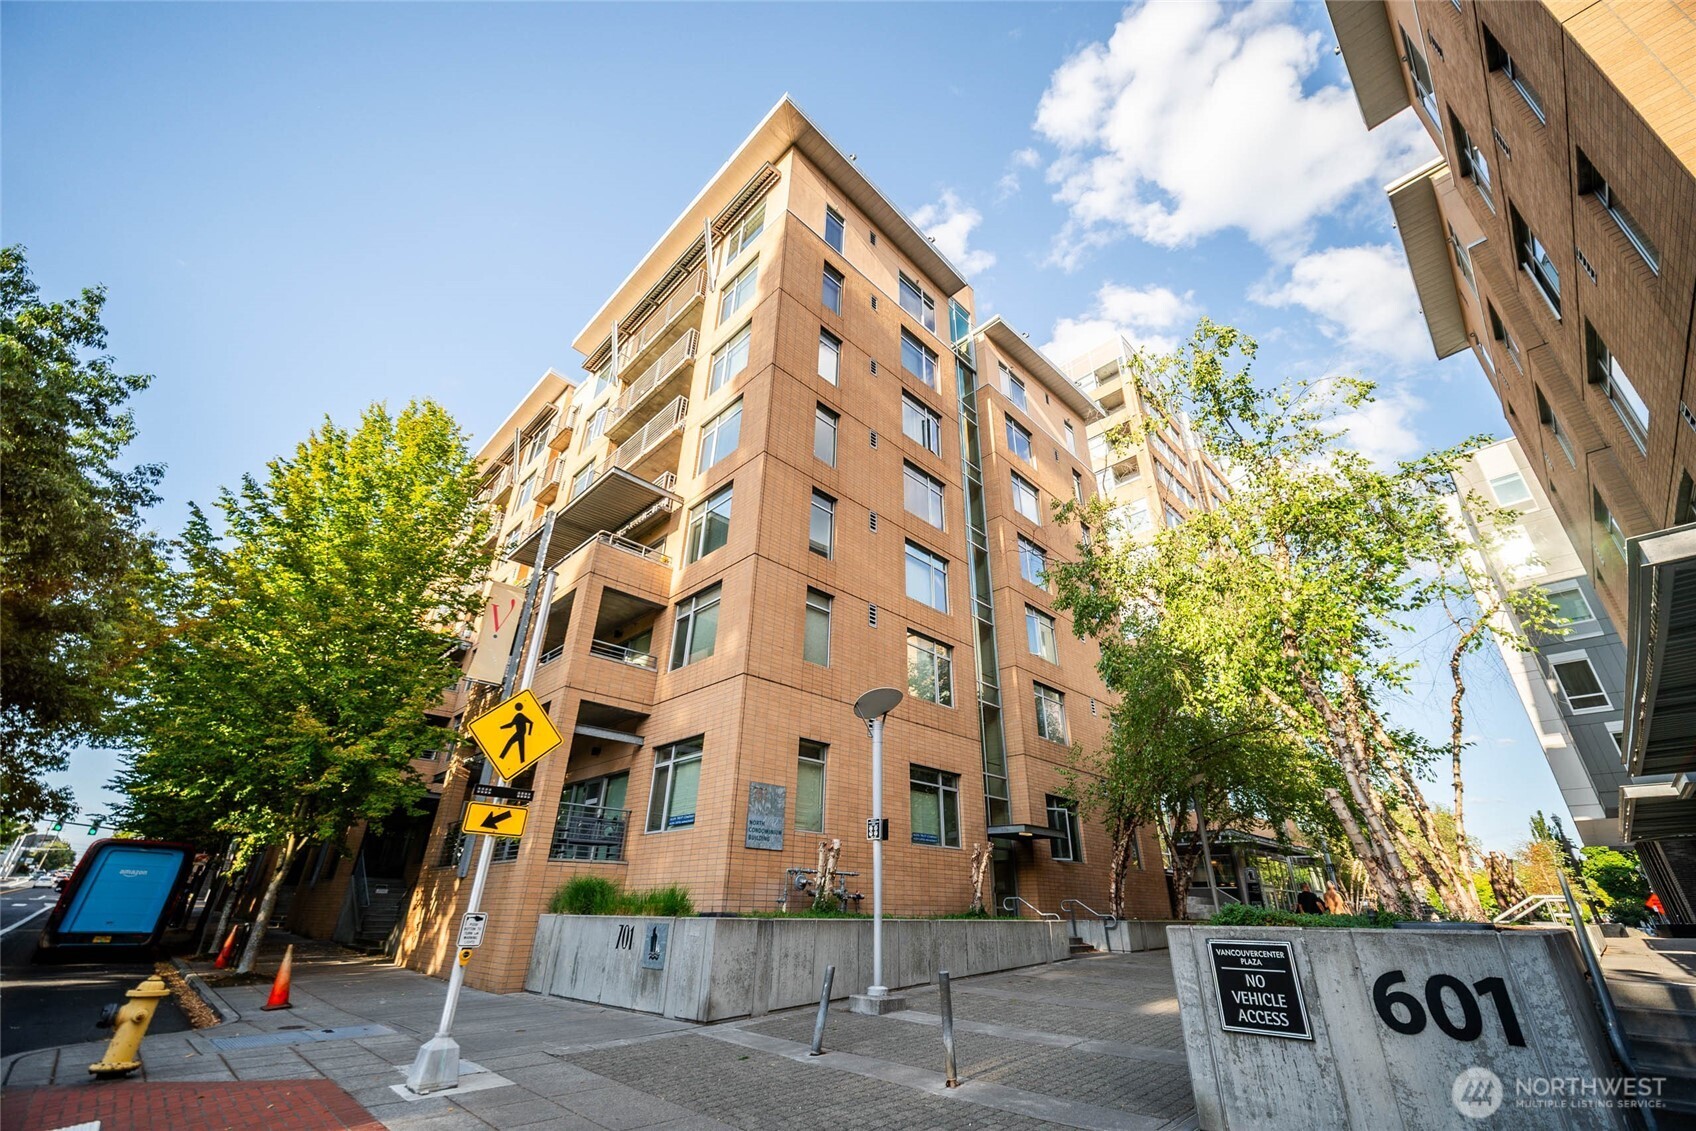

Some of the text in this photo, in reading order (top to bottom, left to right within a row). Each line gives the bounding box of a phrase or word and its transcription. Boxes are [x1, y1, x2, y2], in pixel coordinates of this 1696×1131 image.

[748, 826, 783, 836] CONDOMINIUM
[747, 834, 771, 842] BUILDING
[119, 869, 149, 878] amazon
[615, 924, 635, 950] 701
[1215, 948, 1285, 959] VANCOUVERCENTER
[1240, 958, 1263, 966] PLAZA
[1245, 973, 1266, 988] NO
[1231, 990, 1288, 1008] VEHICLE
[1373, 970, 1527, 1048] 601
[1238, 1008, 1290, 1027] ACCESS
